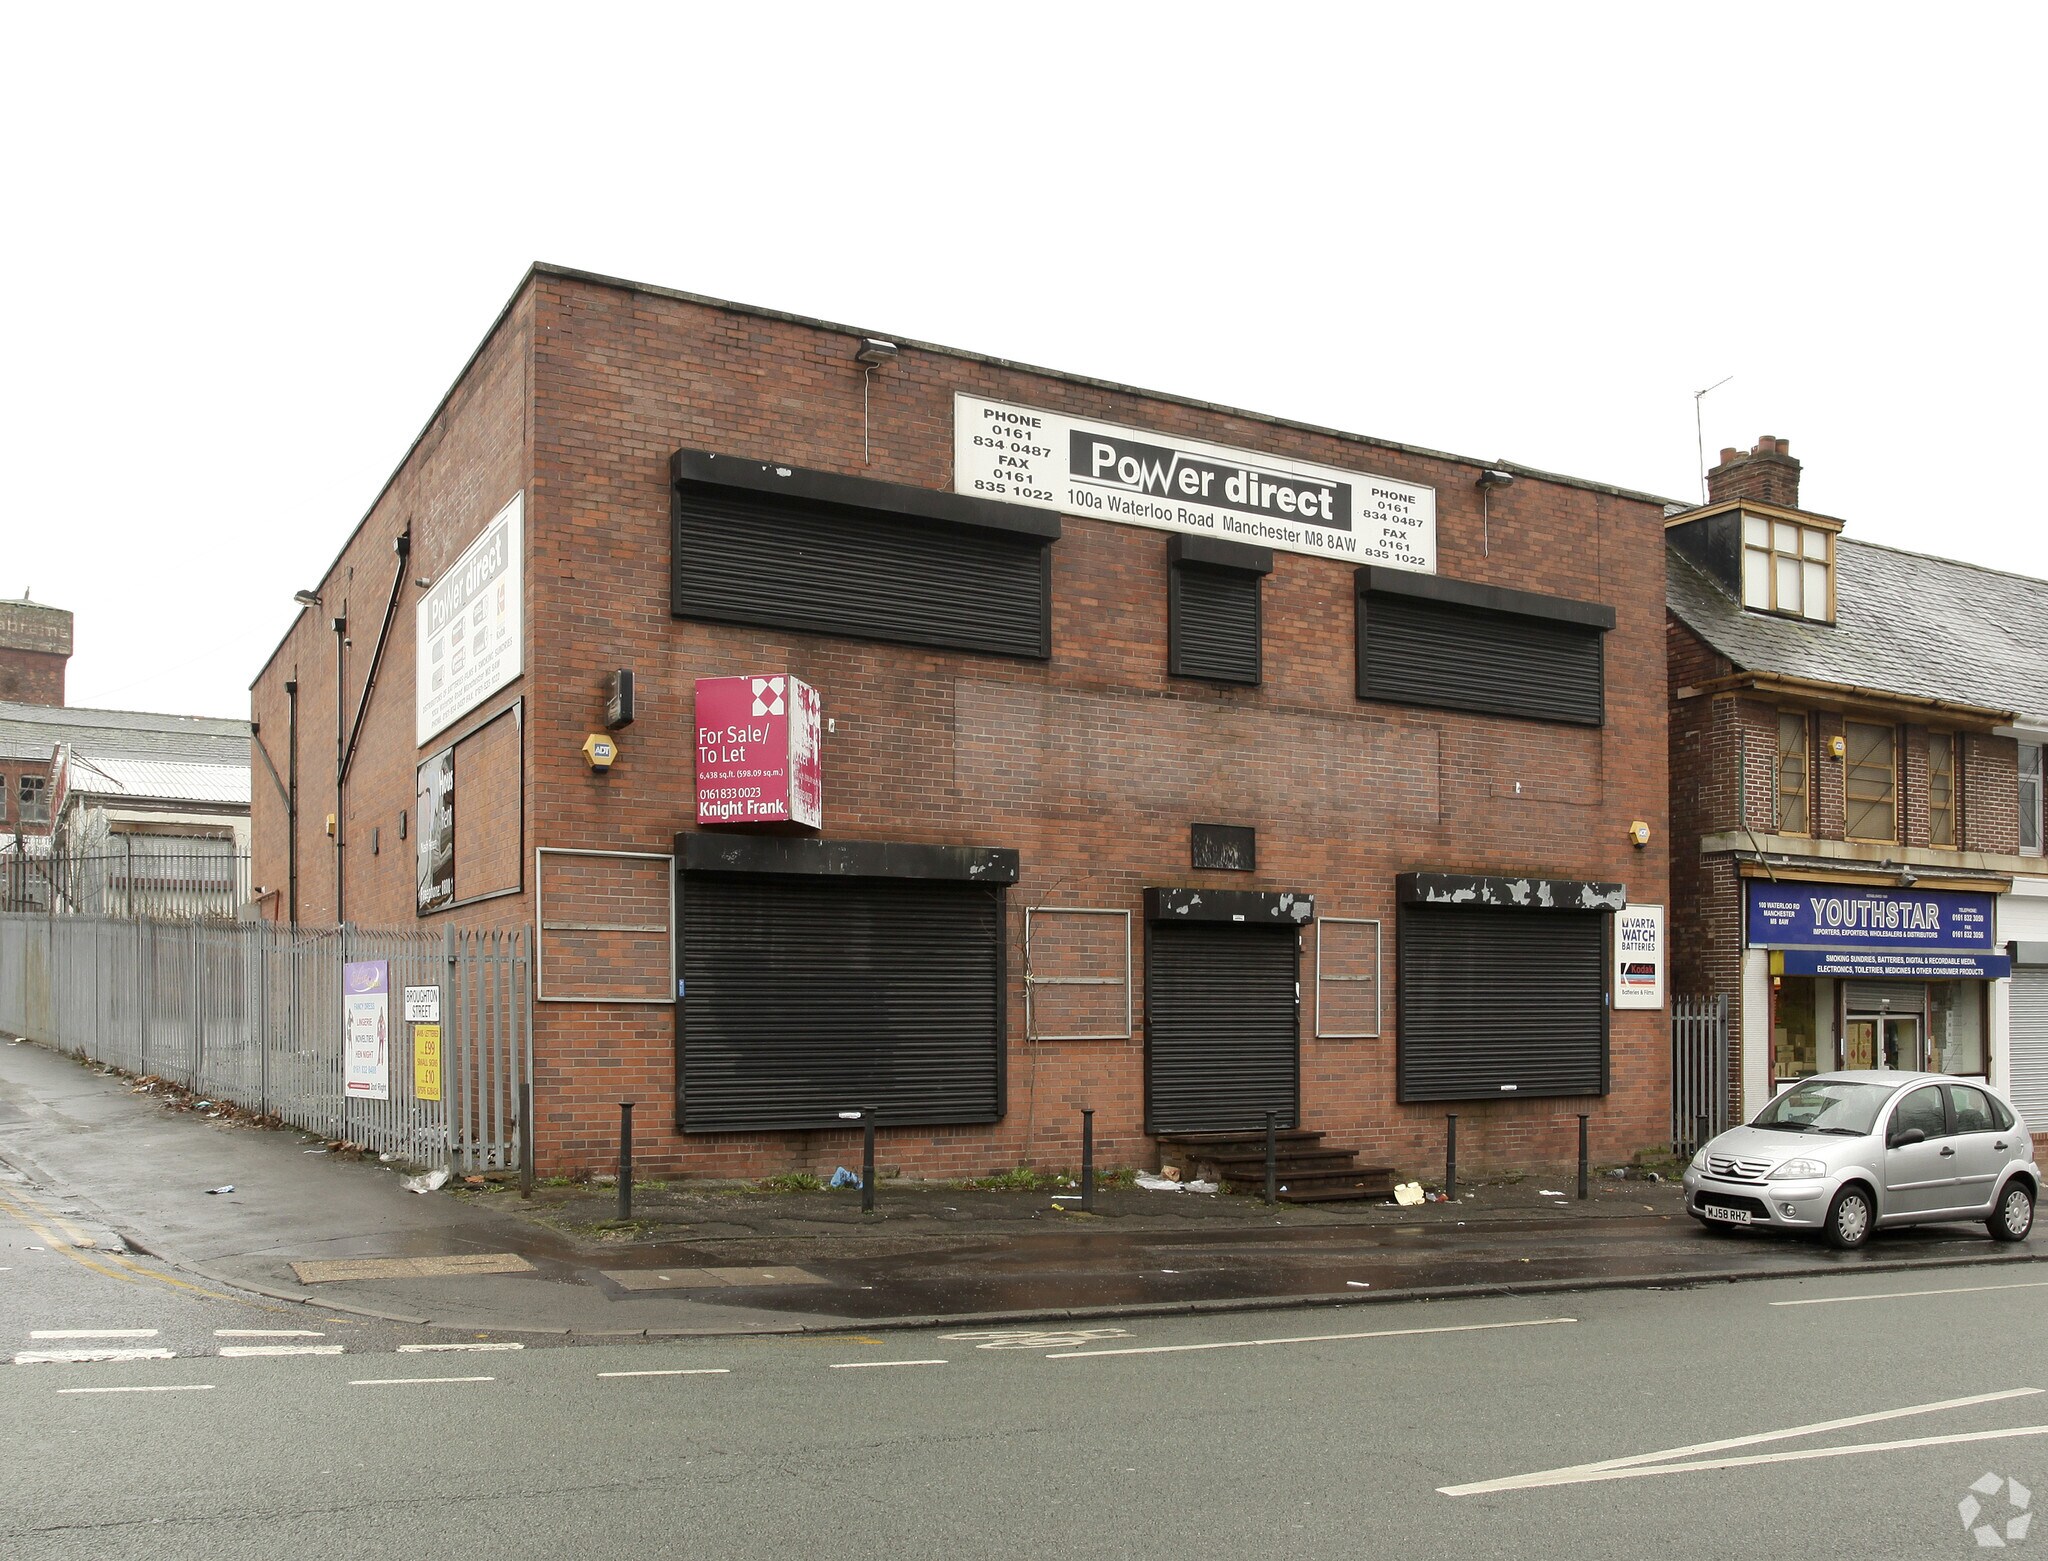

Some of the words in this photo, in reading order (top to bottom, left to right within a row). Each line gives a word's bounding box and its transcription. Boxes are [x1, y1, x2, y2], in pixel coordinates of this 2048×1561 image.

[984, 408, 1041, 428] PHONE
[992, 425, 1031, 440] 0161
[973, 435, 1004, 450] 834
[1011, 443, 1051, 458] 0487
[998, 455, 1029, 469] FAX
[993, 469, 1032, 484] 0161
[1092, 442, 1214, 497] Power
[1224, 470, 1333, 520] direct
[974, 480, 1006, 493] 835
[1013, 487, 1053, 501] 1022
[1371, 487, 1415, 505] PHONE
[1378, 501, 1408, 514] 0161
[1068, 489, 1102, 510] 100a
[1107, 495, 1172, 521] Waterloo
[1178, 507, 1214, 528] Road
[1223, 515, 1301, 543] Manchester
[1305, 530, 1323, 547] M8
[1328, 534, 1356, 552] 8AW
[1363, 509, 1387, 521] 834
[1392, 515, 1423, 528] 0487
[1383, 528, 1407, 540] FAX
[1379, 539, 1410, 551] 0161
[1365, 548, 1389, 559] 835
[1395, 553, 1425, 566] 1022
[432, 574, 464, 630] Power
[466, 533, 501, 596] direct
[699, 728, 723, 744] For
[727, 723, 769, 744] Sale/
[595, 746, 610, 755] ADT
[699, 747, 717, 764] To
[722, 746, 745, 763] Let
[700, 772, 717, 780] 6,438
[719, 770, 735, 779] sq.ft.
[763, 768, 784, 778] sq.m.)
[700, 789, 720, 799] 0161
[738, 787, 761, 798] 0023
[700, 801, 743, 819] Knight
[1764, 910, 1795, 918] MANCHESTER
[1810, 898, 1940, 929] YOUTHSTAR
[1630, 919, 1655, 929] VARTA
[1622, 930, 1655, 942] WATCH
[1869, 930, 1902, 938] WHOLESALERS
[1622, 943, 1655, 951] BATTERIES
[1631, 964, 1653, 973] Kodak
[406, 989, 438, 1002] BROUGHTON
[412, 1004, 431, 1018] STREET
[1708, 1208, 1728, 1219] MJ58
[1730, 1211, 1747, 1221] RHZ
